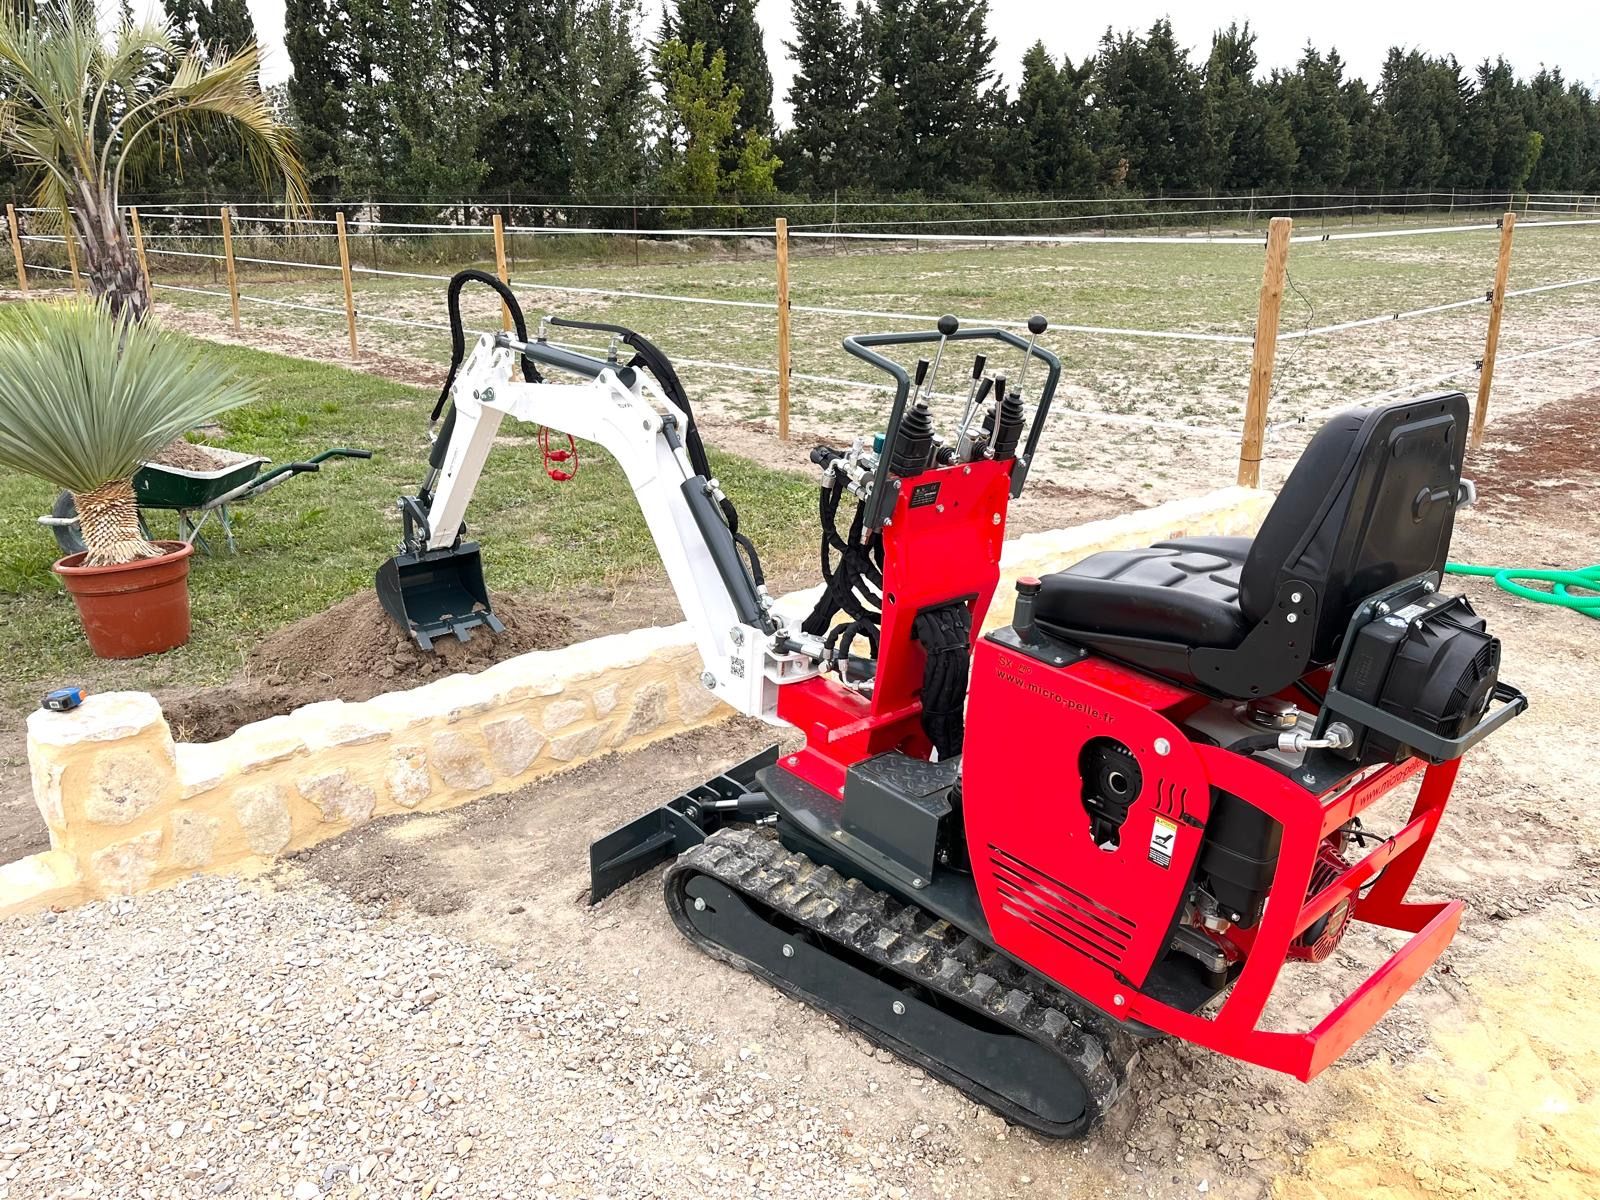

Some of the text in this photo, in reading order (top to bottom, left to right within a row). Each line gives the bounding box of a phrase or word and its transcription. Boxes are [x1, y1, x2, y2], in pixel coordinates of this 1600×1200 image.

[998, 655, 1012, 669] SX
[996, 669, 1115, 724] www.micro-pelle.fr
[1359, 758, 1424, 807] www.micro-pelle.
